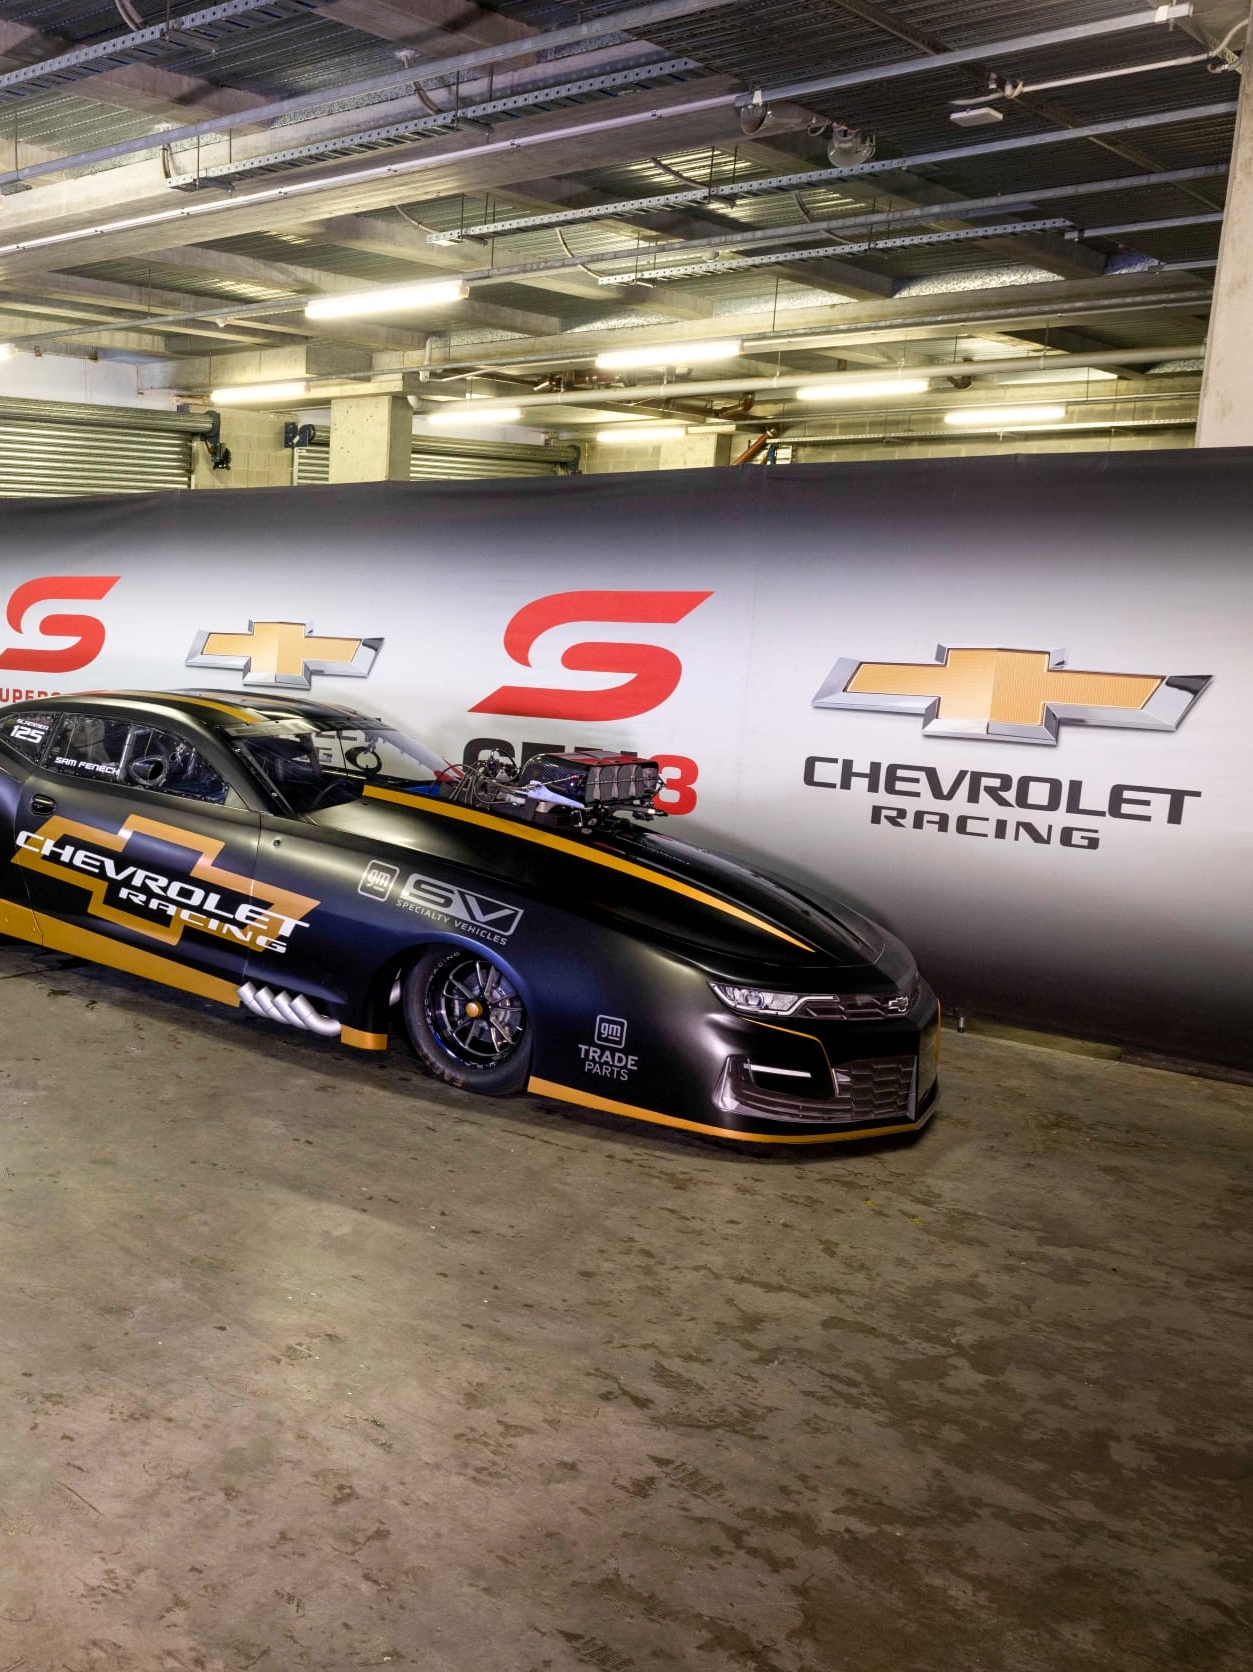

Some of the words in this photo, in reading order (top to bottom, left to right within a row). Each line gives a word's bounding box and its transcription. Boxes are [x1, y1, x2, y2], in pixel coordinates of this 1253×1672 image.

[10, 725, 45, 744] 125
[54, 756, 77, 768] SAM
[78, 761, 121, 777] FENECH
[803, 755, 1202, 825] CHEVROLET
[870, 805, 1101, 850] RACING
[15, 830, 311, 937] CHEVROLET
[118, 887, 287, 954] RACING
[396, 899, 451, 924] SPECIALTY
[454, 919, 508, 946] VEHICLES
[578, 1044, 639, 1070] TRADE
[585, 1061, 628, 1080] PARTS
